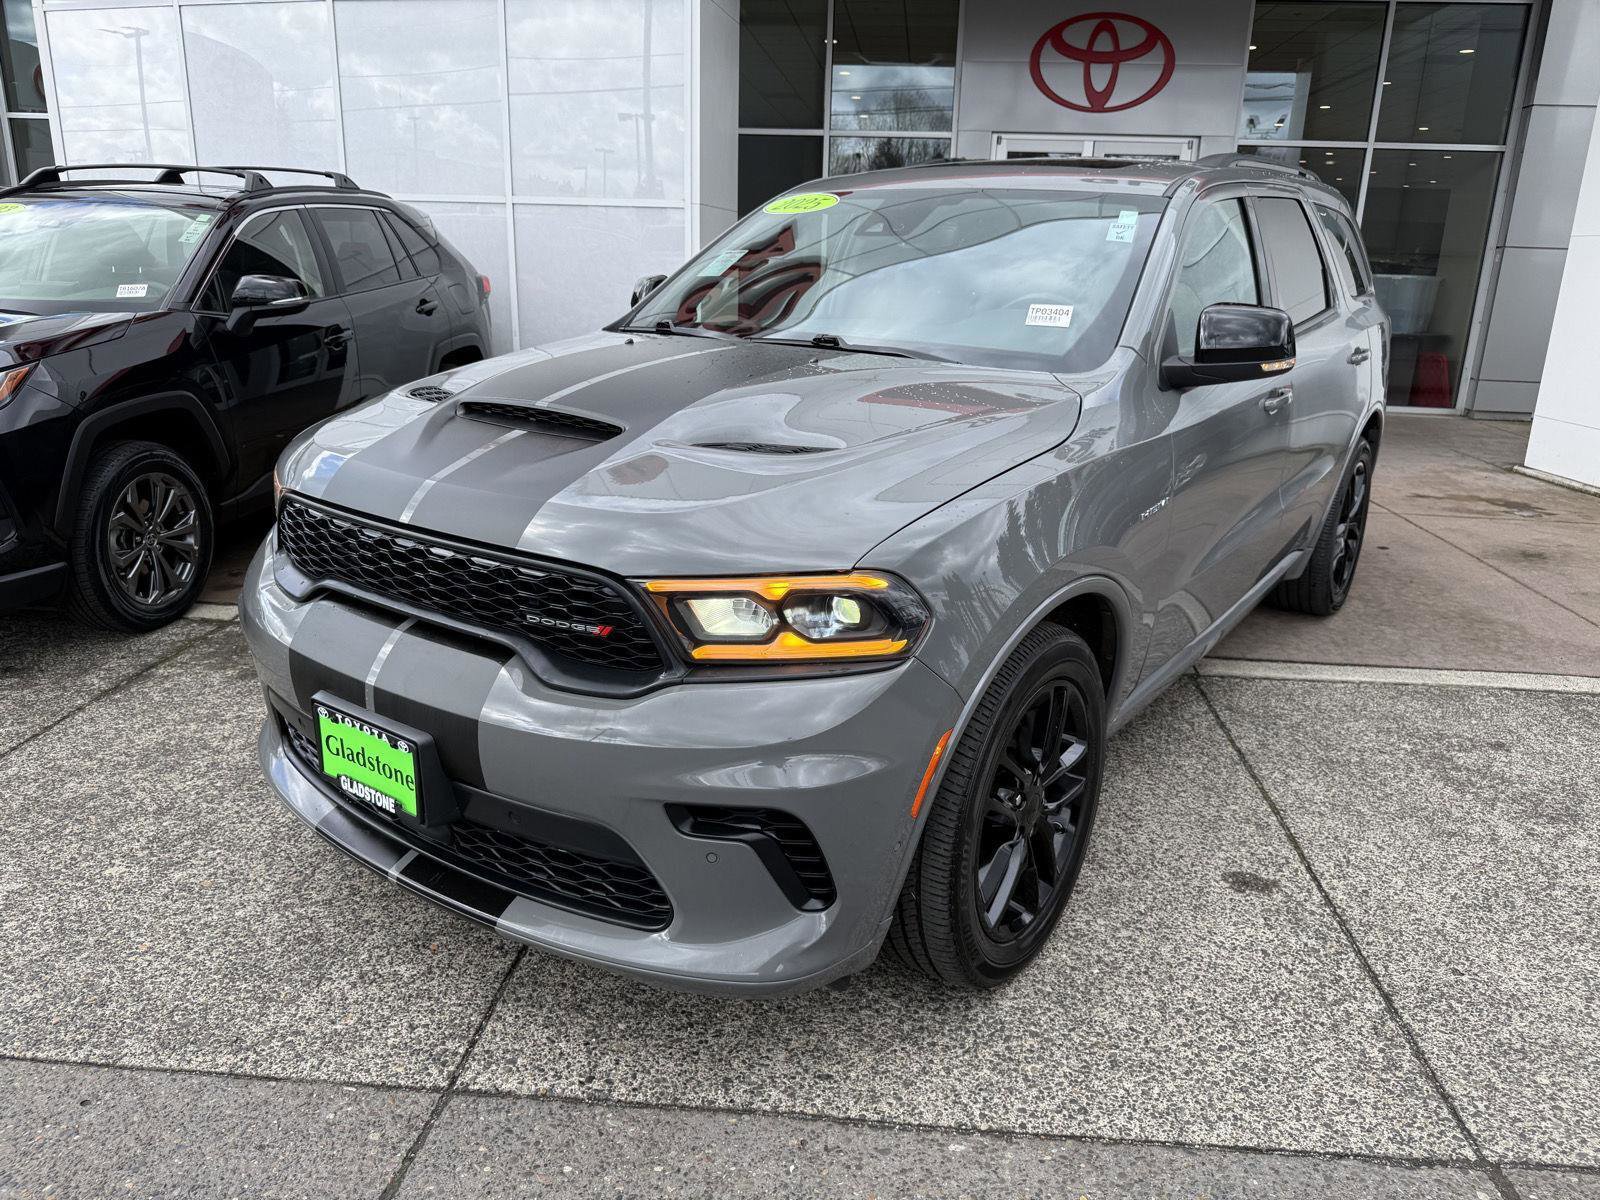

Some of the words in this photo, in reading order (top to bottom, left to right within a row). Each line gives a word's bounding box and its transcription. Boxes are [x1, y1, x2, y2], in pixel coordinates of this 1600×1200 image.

[1031, 307, 1070, 317] TP03404
[526, 614, 600, 634] DODGE
[335, 713, 390, 743] TOYOTA
[325, 734, 415, 792] Gladstone
[340, 775, 396, 814] GLADSTONE
